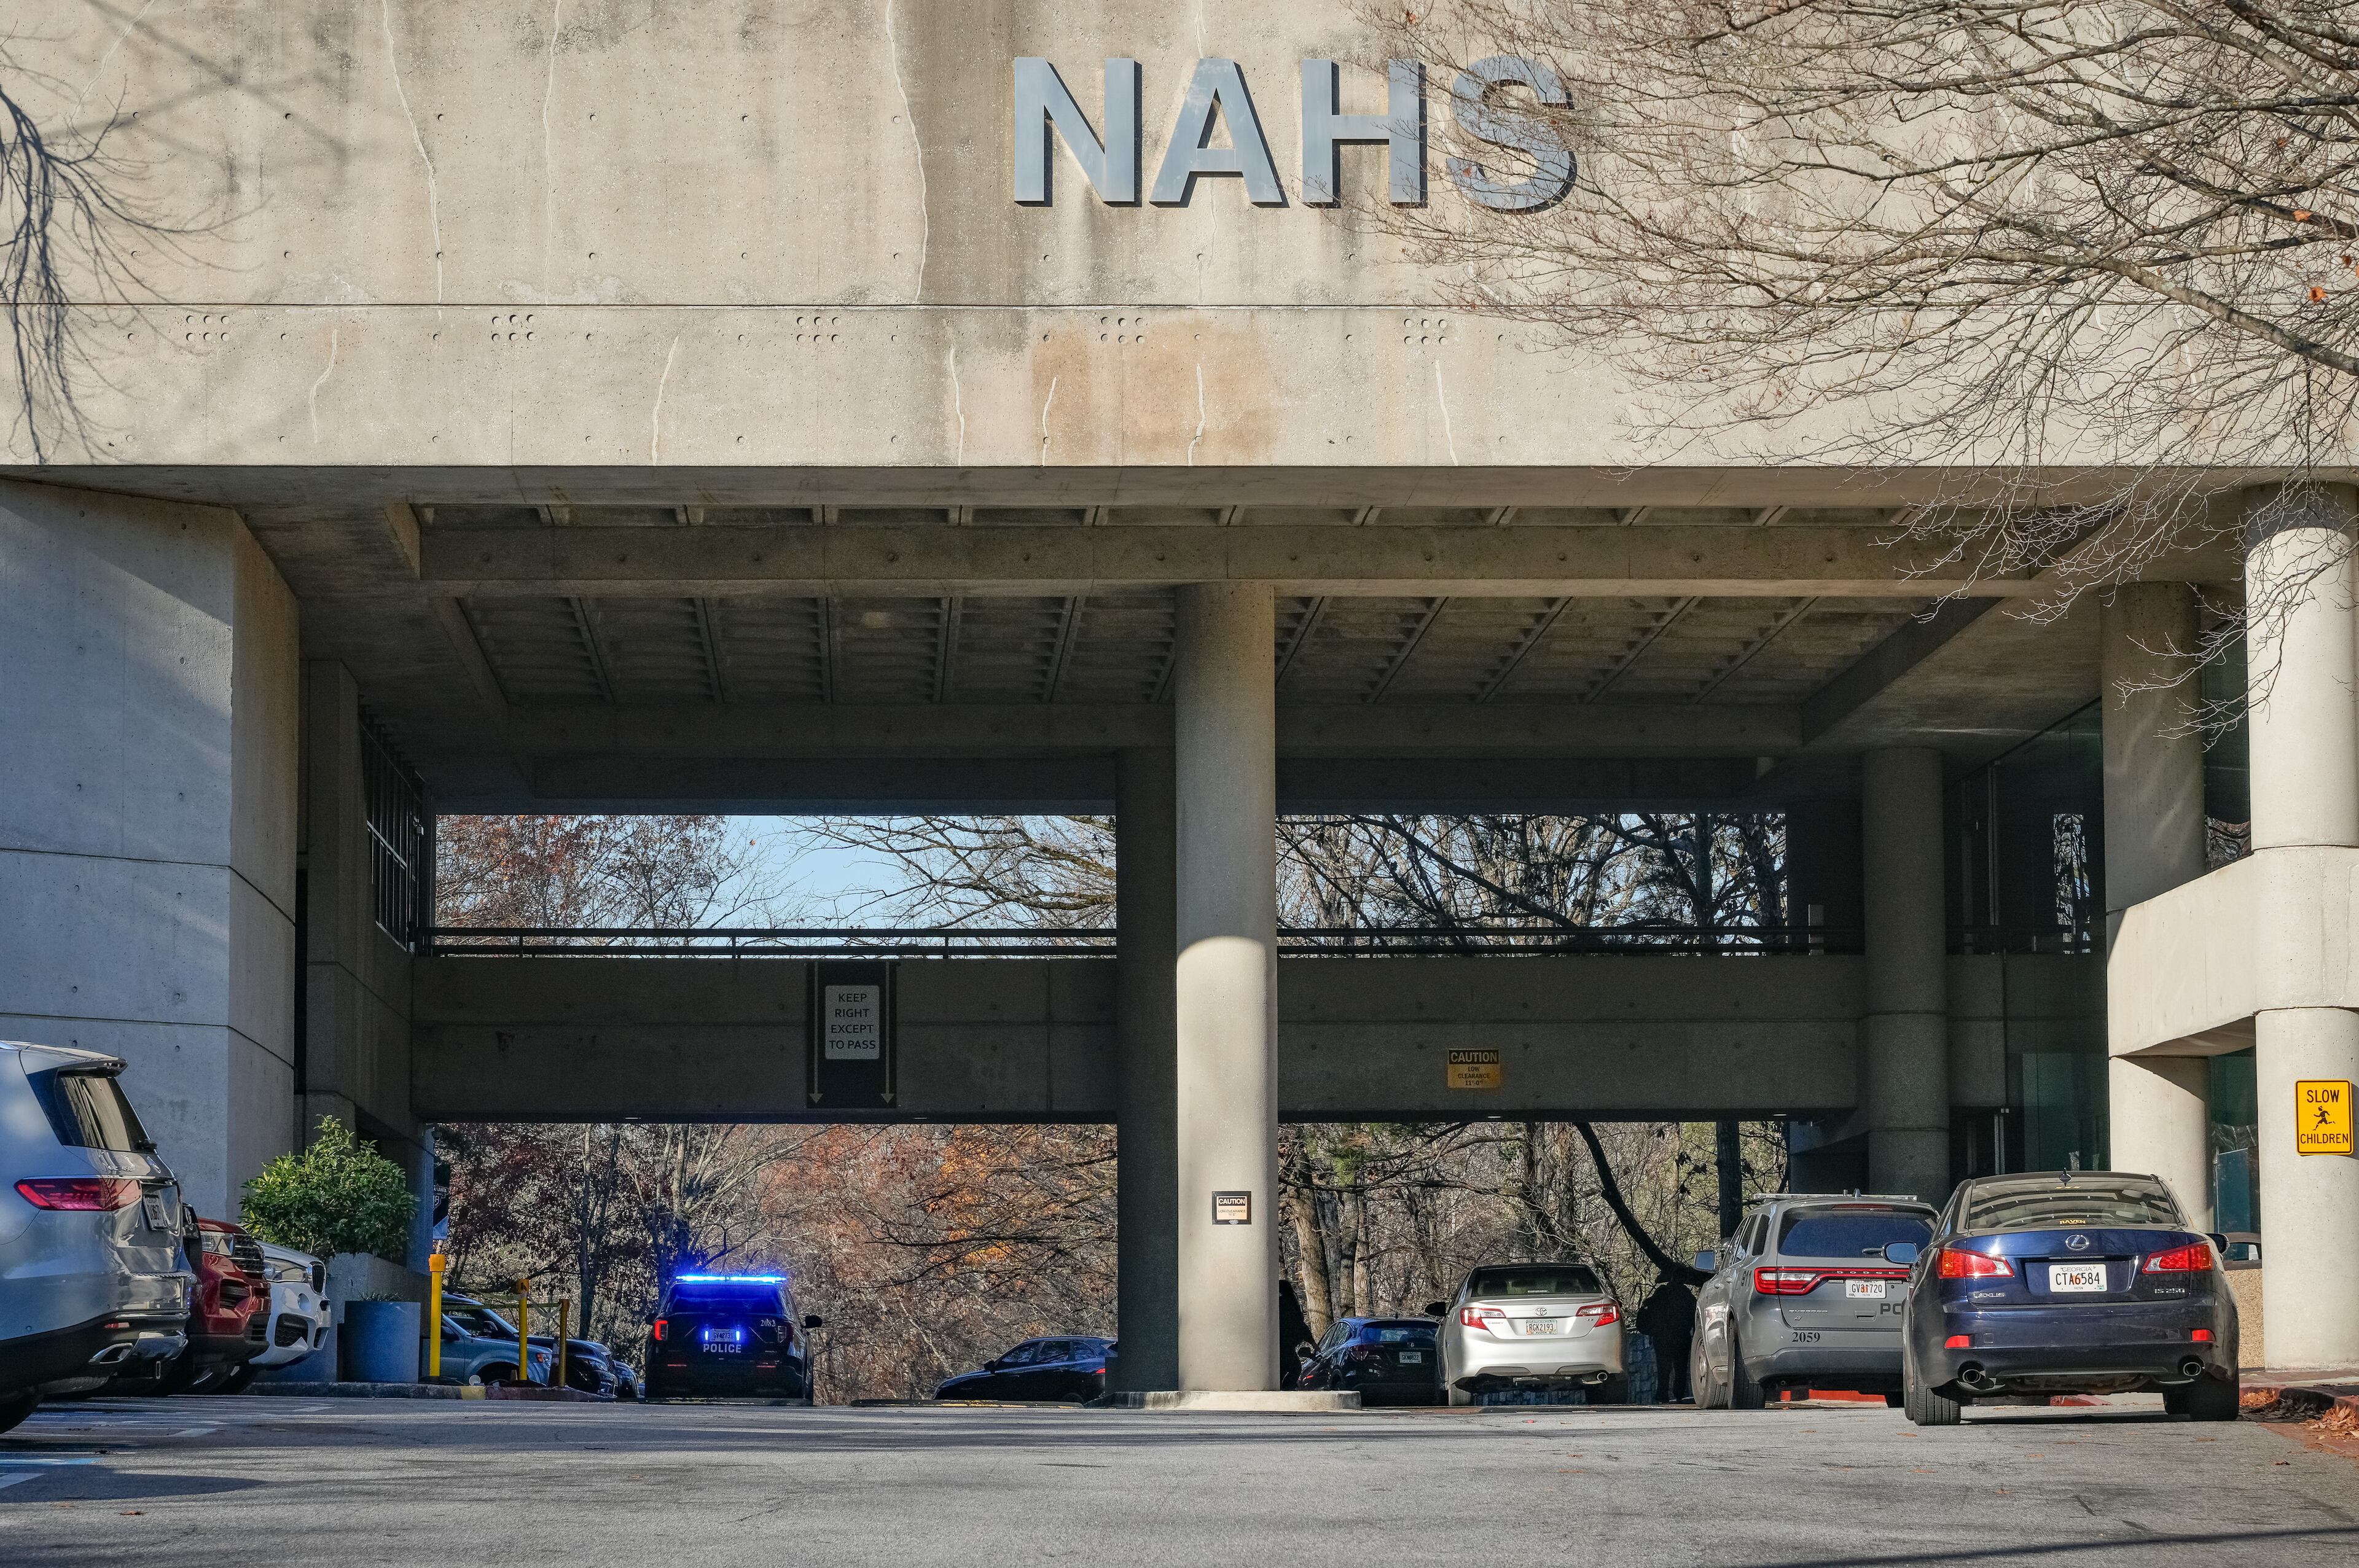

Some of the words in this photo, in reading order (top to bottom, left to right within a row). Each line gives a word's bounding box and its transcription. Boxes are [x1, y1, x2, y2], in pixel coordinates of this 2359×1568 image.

[1014, 56, 1578, 212] NAHS
[838, 993, 867, 1002] KEEP
[835, 1008, 870, 1018] RIGHT
[831, 1024, 874, 1034] EXCEPT
[829, 1040, 845, 1050] TO
[847, 1040, 876, 1050] PASS
[1450, 1051, 1497, 1063] CAUTION
[2306, 1090, 2339, 1103] SLOW
[2300, 1133, 2349, 1144] CHILDREN
[1741, 1270, 1752, 1287] 911
[2056, 1272, 2100, 1285] CTA6584
[761, 1319, 776, 1327] 2082
[1529, 1323, 1554, 1332] RGK2193
[1791, 1332, 1821, 1343] 2059
[703, 1343, 741, 1353] POLICE
